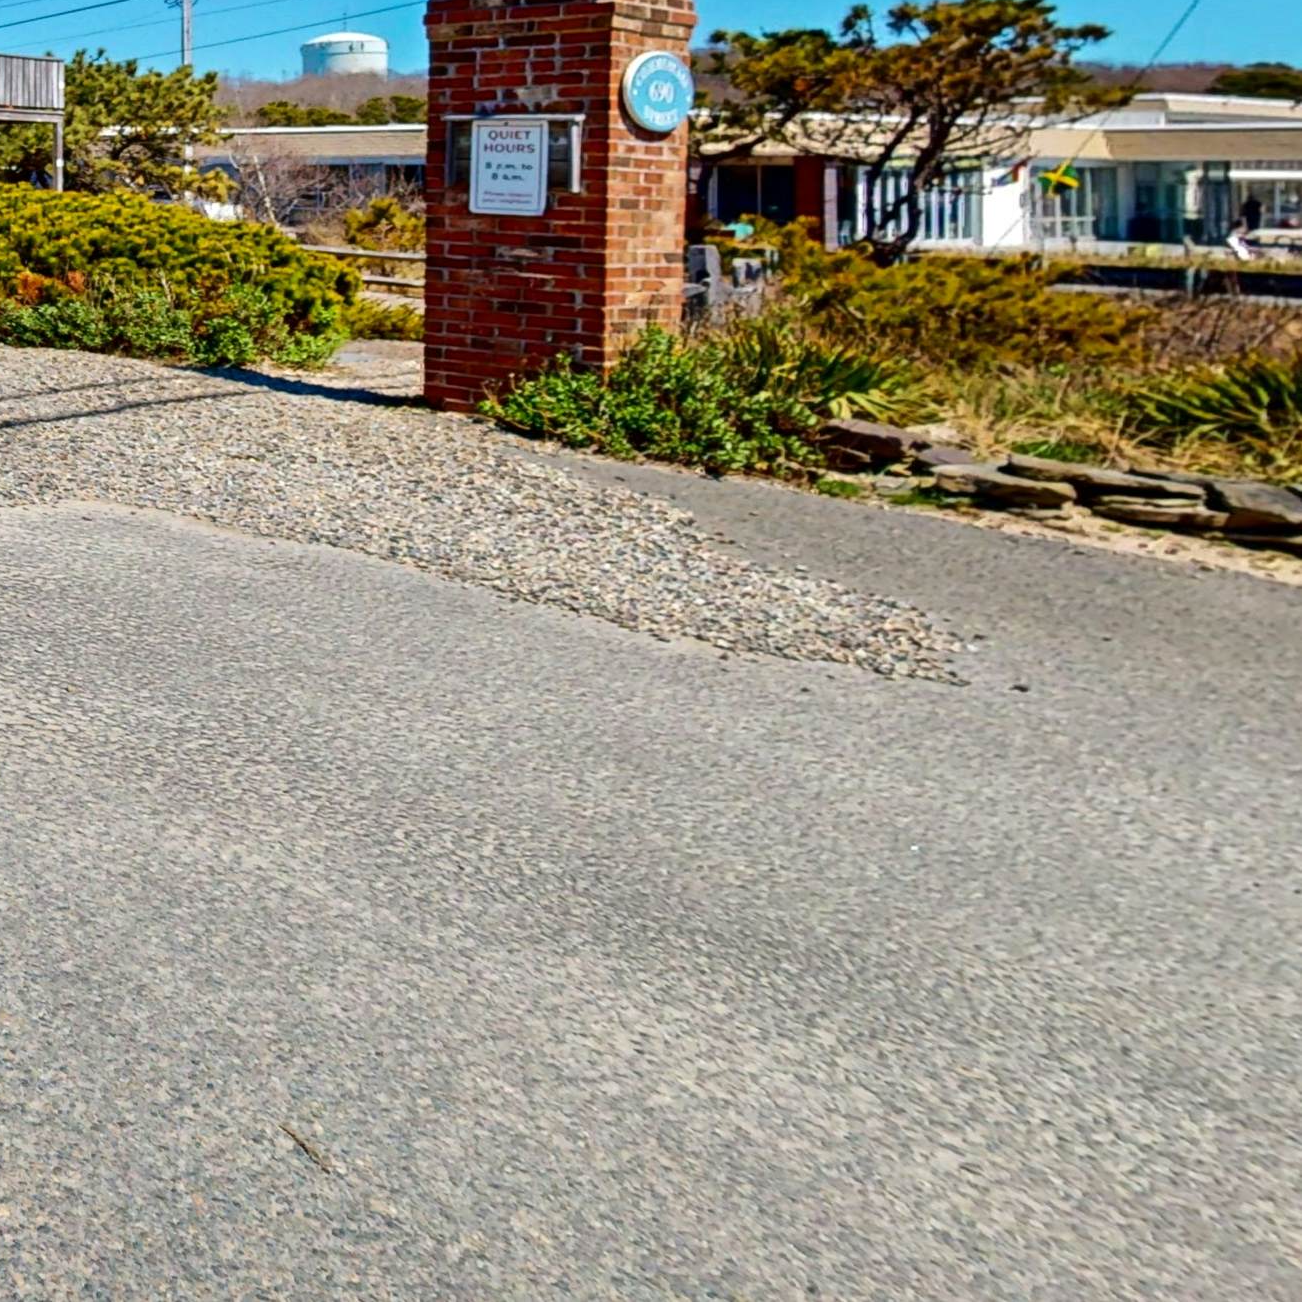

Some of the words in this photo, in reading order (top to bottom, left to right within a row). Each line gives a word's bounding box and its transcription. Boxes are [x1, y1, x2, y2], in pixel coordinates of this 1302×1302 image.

[648, 80, 675, 104] 690
[488, 130, 531, 141] QUIET
[484, 144, 535, 154] HOURS
